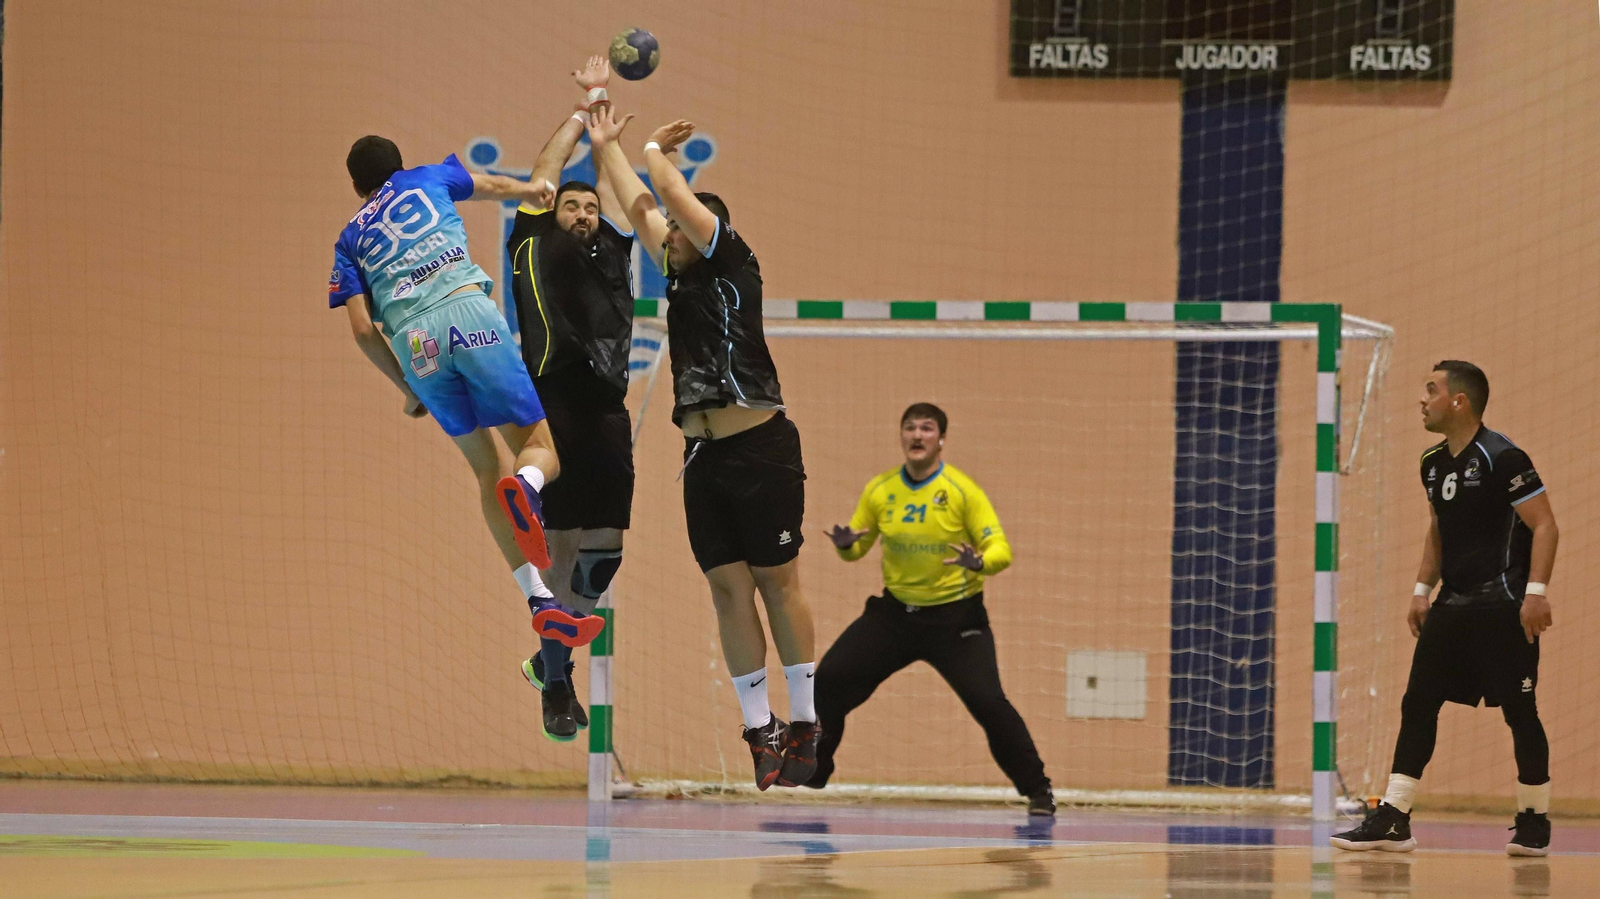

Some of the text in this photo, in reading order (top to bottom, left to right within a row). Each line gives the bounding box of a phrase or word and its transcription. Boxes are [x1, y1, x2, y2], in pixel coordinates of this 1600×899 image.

[1029, 44, 1109, 69] FALTAS
[1175, 45, 1278, 70] JUGADOR
[1350, 45, 1431, 71] FALTAS
[410, 260, 440, 282] AUTO
[448, 325, 502, 356] ARILA
[1441, 472, 1458, 500] 6
[902, 503, 927, 523] 21
